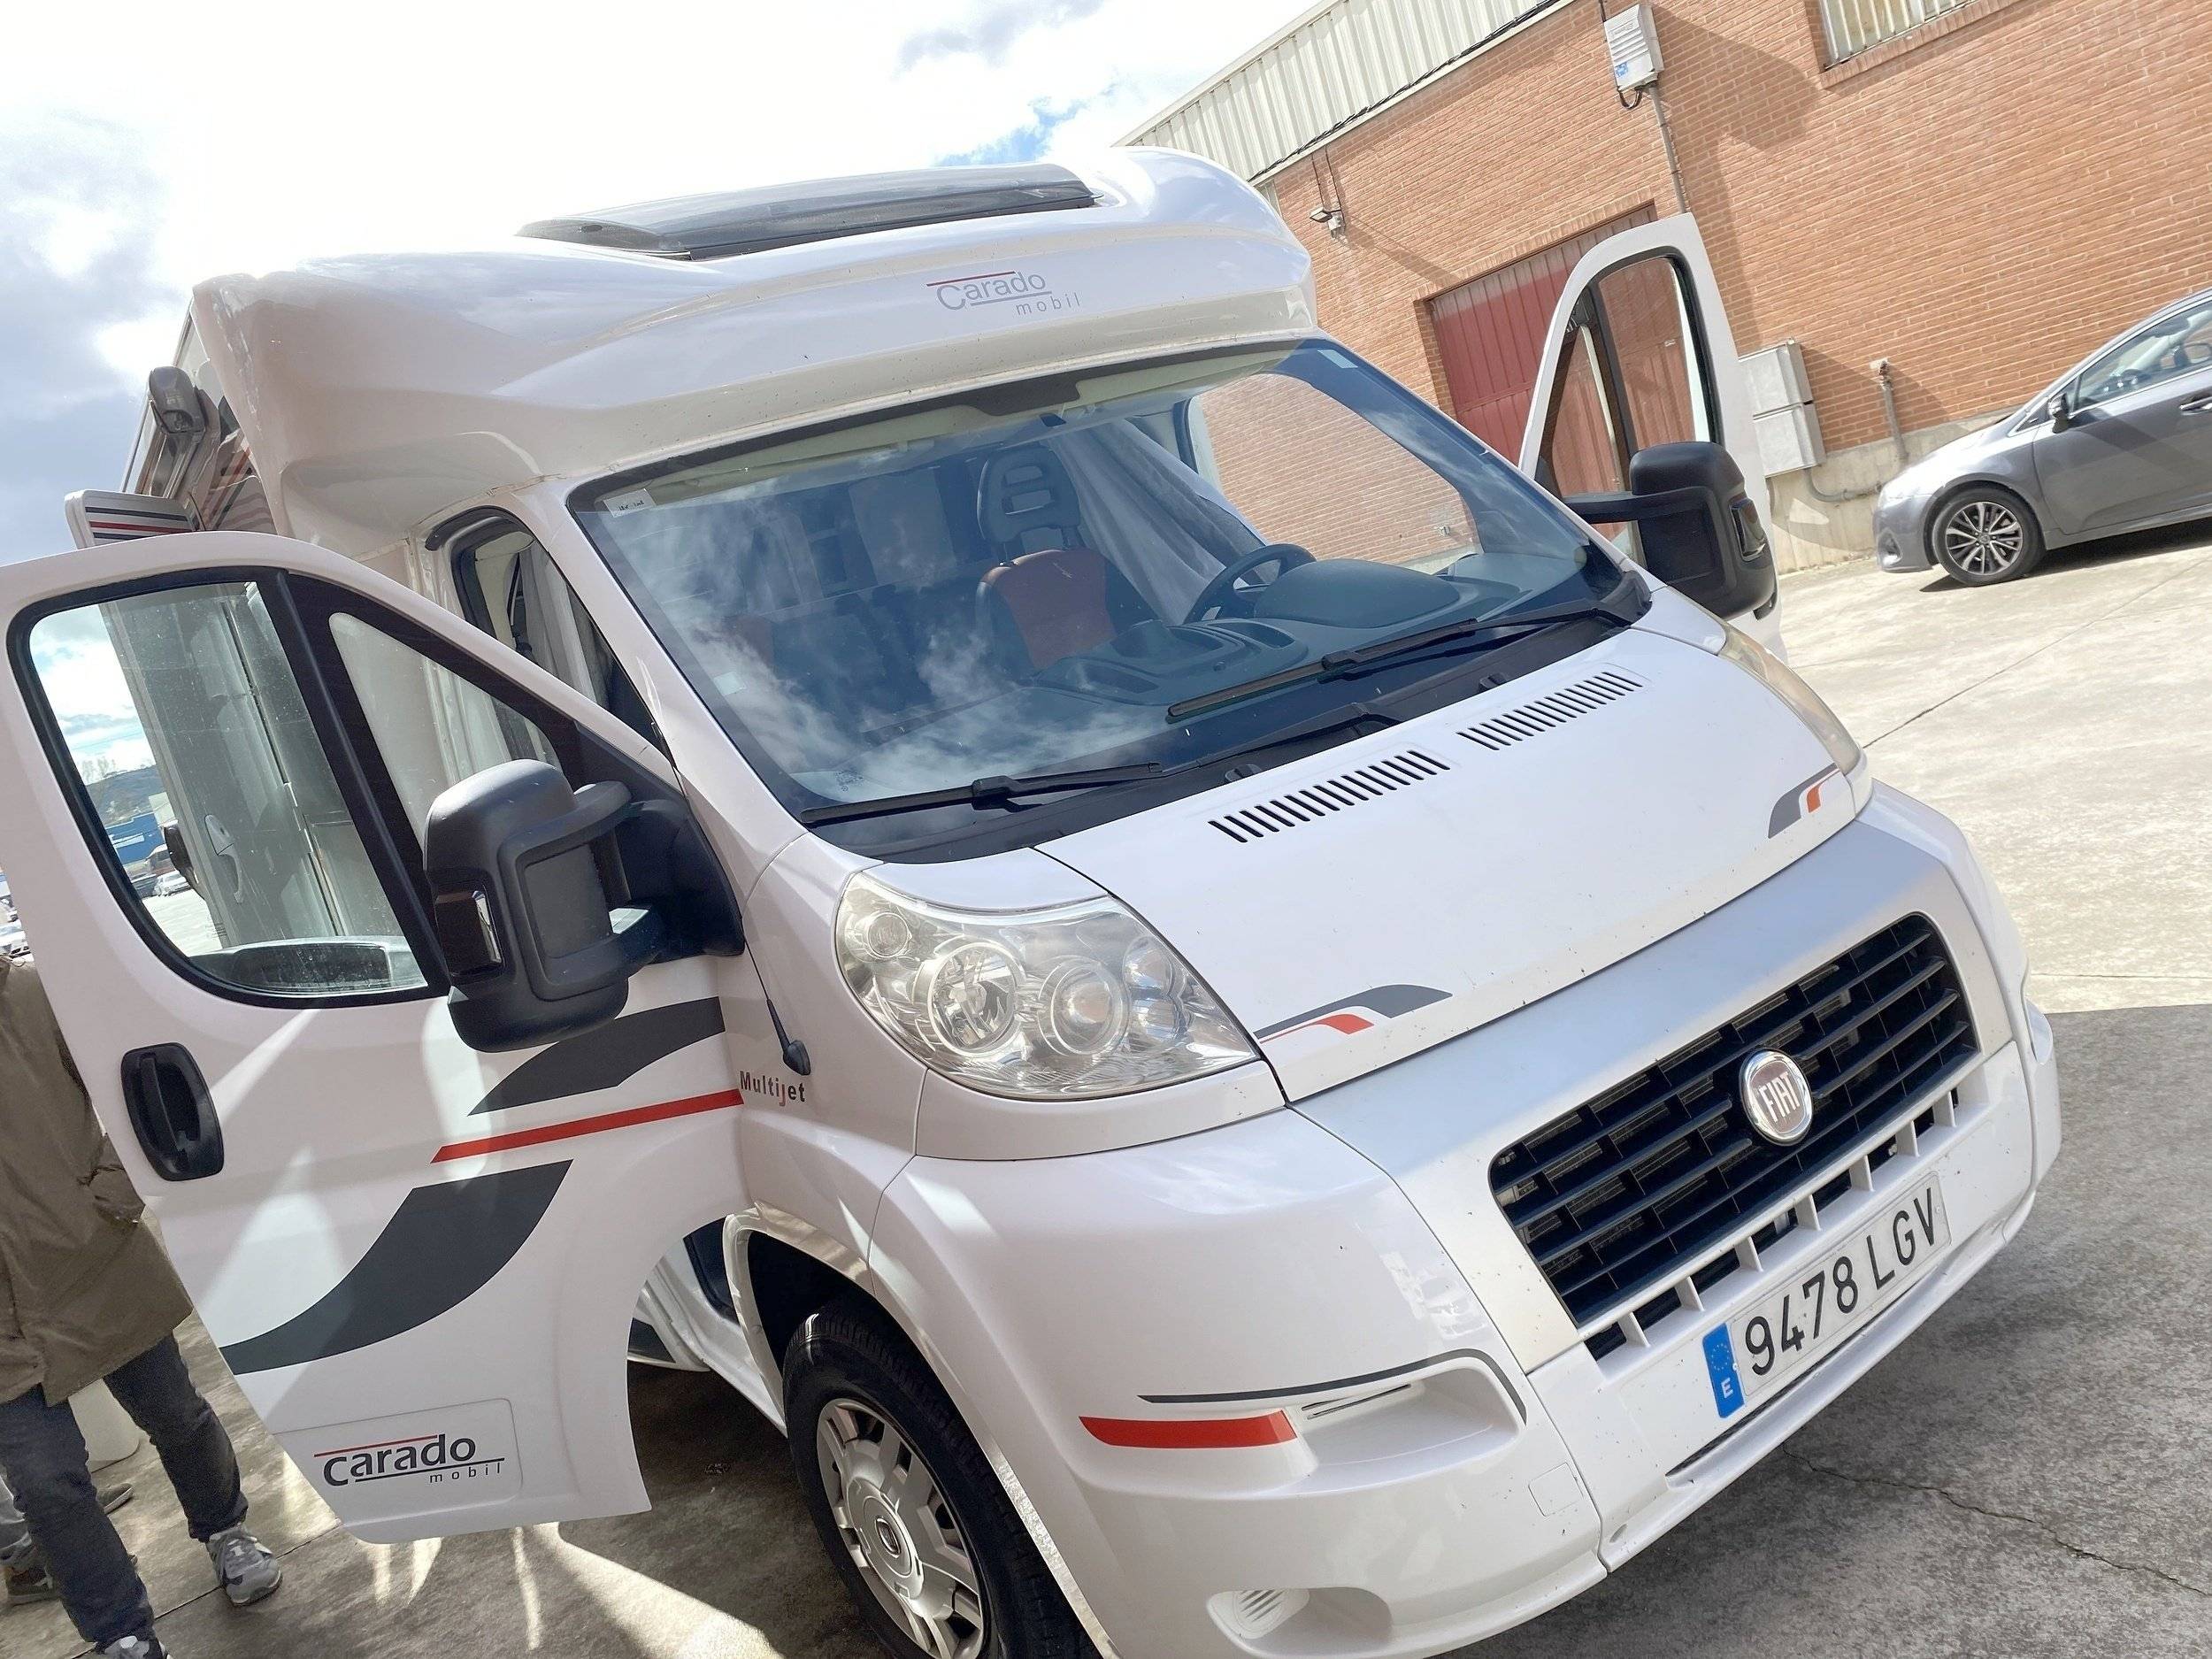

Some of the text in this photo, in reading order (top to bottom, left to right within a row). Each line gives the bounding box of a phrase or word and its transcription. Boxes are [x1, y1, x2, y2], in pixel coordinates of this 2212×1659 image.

[1017, 292, 1081, 316] mobil
[1758, 1071, 1800, 1123] FIAT
[1745, 1187, 1935, 1375] 9478 LGV
[1721, 1377, 1734, 1399] E
[430, 1462, 501, 1484] mobil
